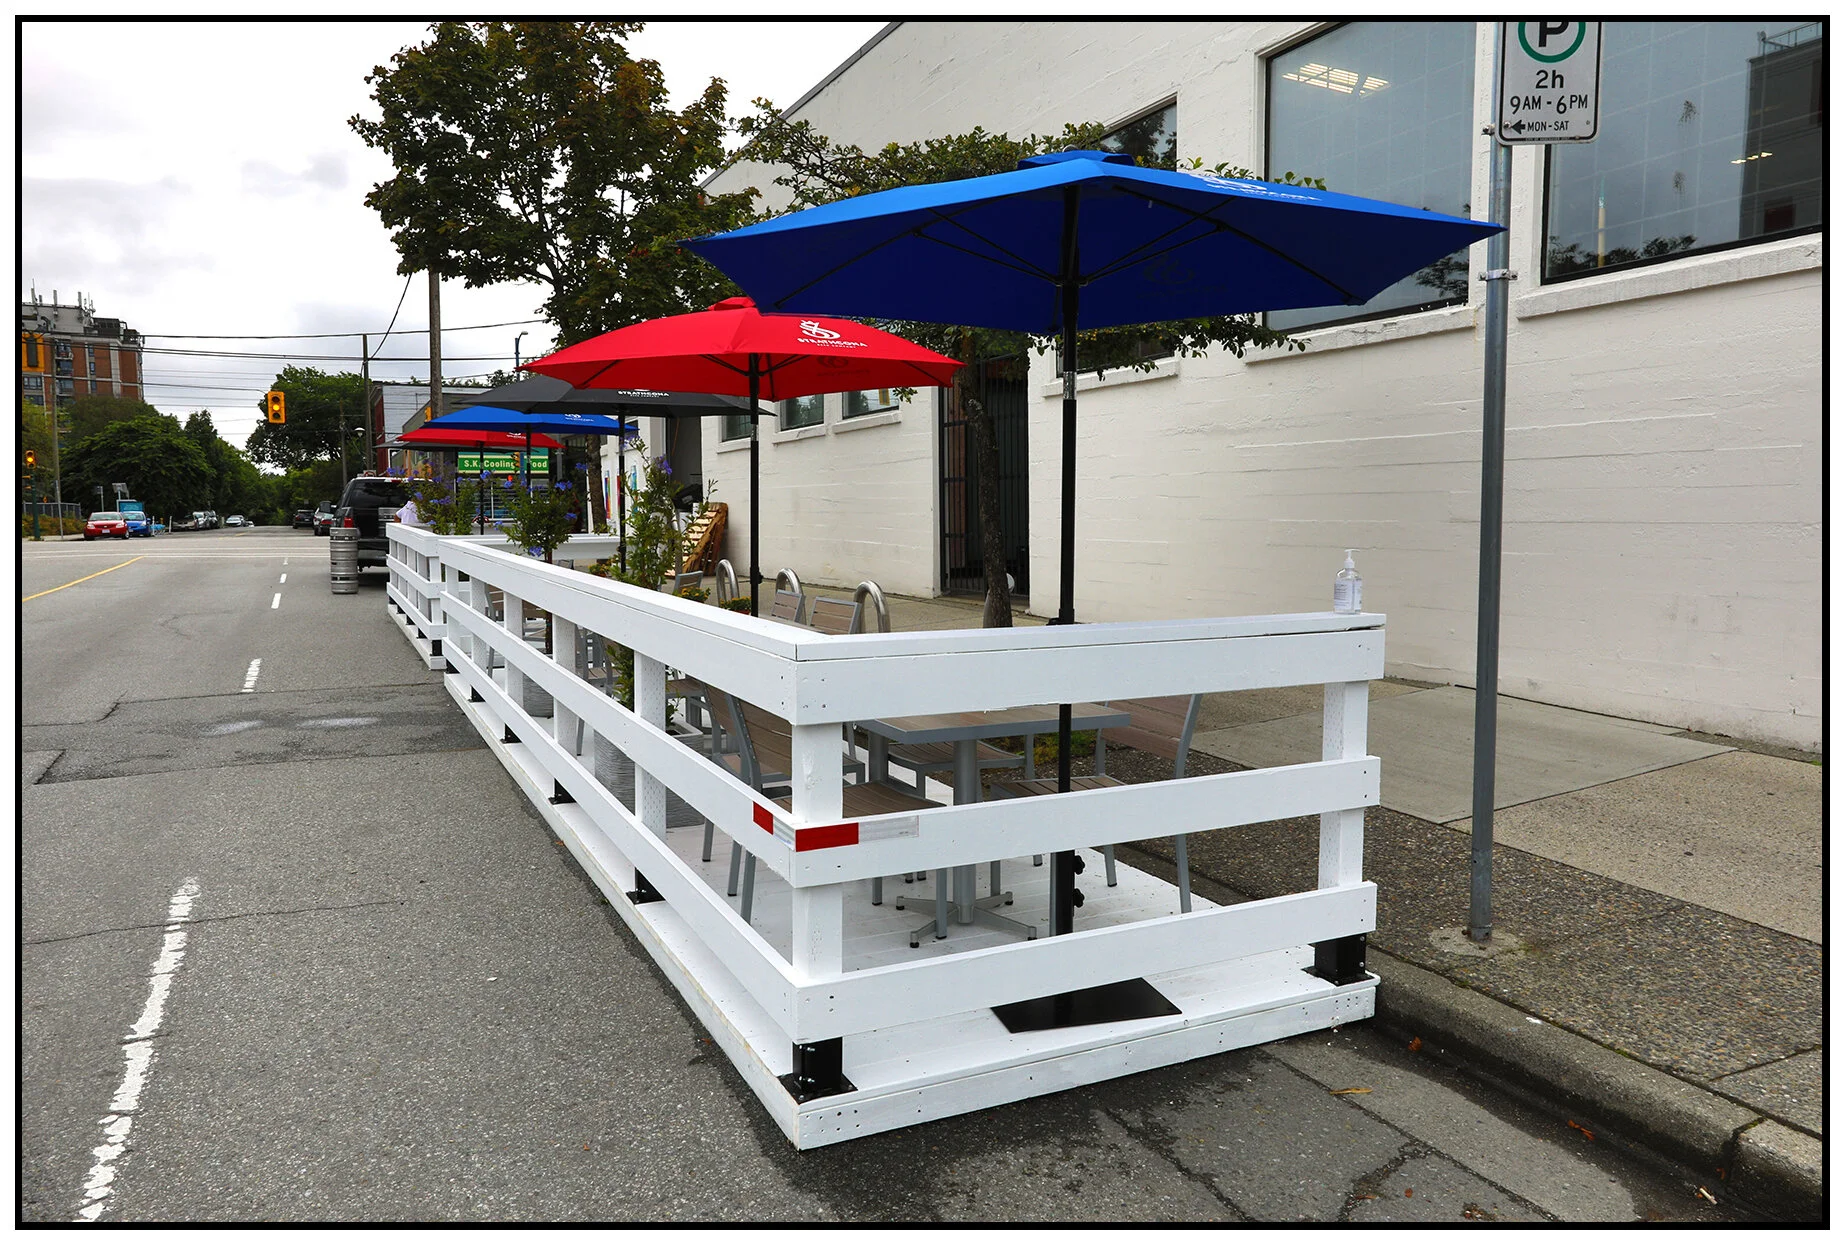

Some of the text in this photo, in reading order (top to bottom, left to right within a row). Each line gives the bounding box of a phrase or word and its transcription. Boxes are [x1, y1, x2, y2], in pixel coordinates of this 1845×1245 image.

[1535, 69, 1564, 89] 2h
[1510, 95, 1542, 115] 9AM
[1556, 94, 1588, 115] 6PM
[483, 459, 516, 470] Cooling
